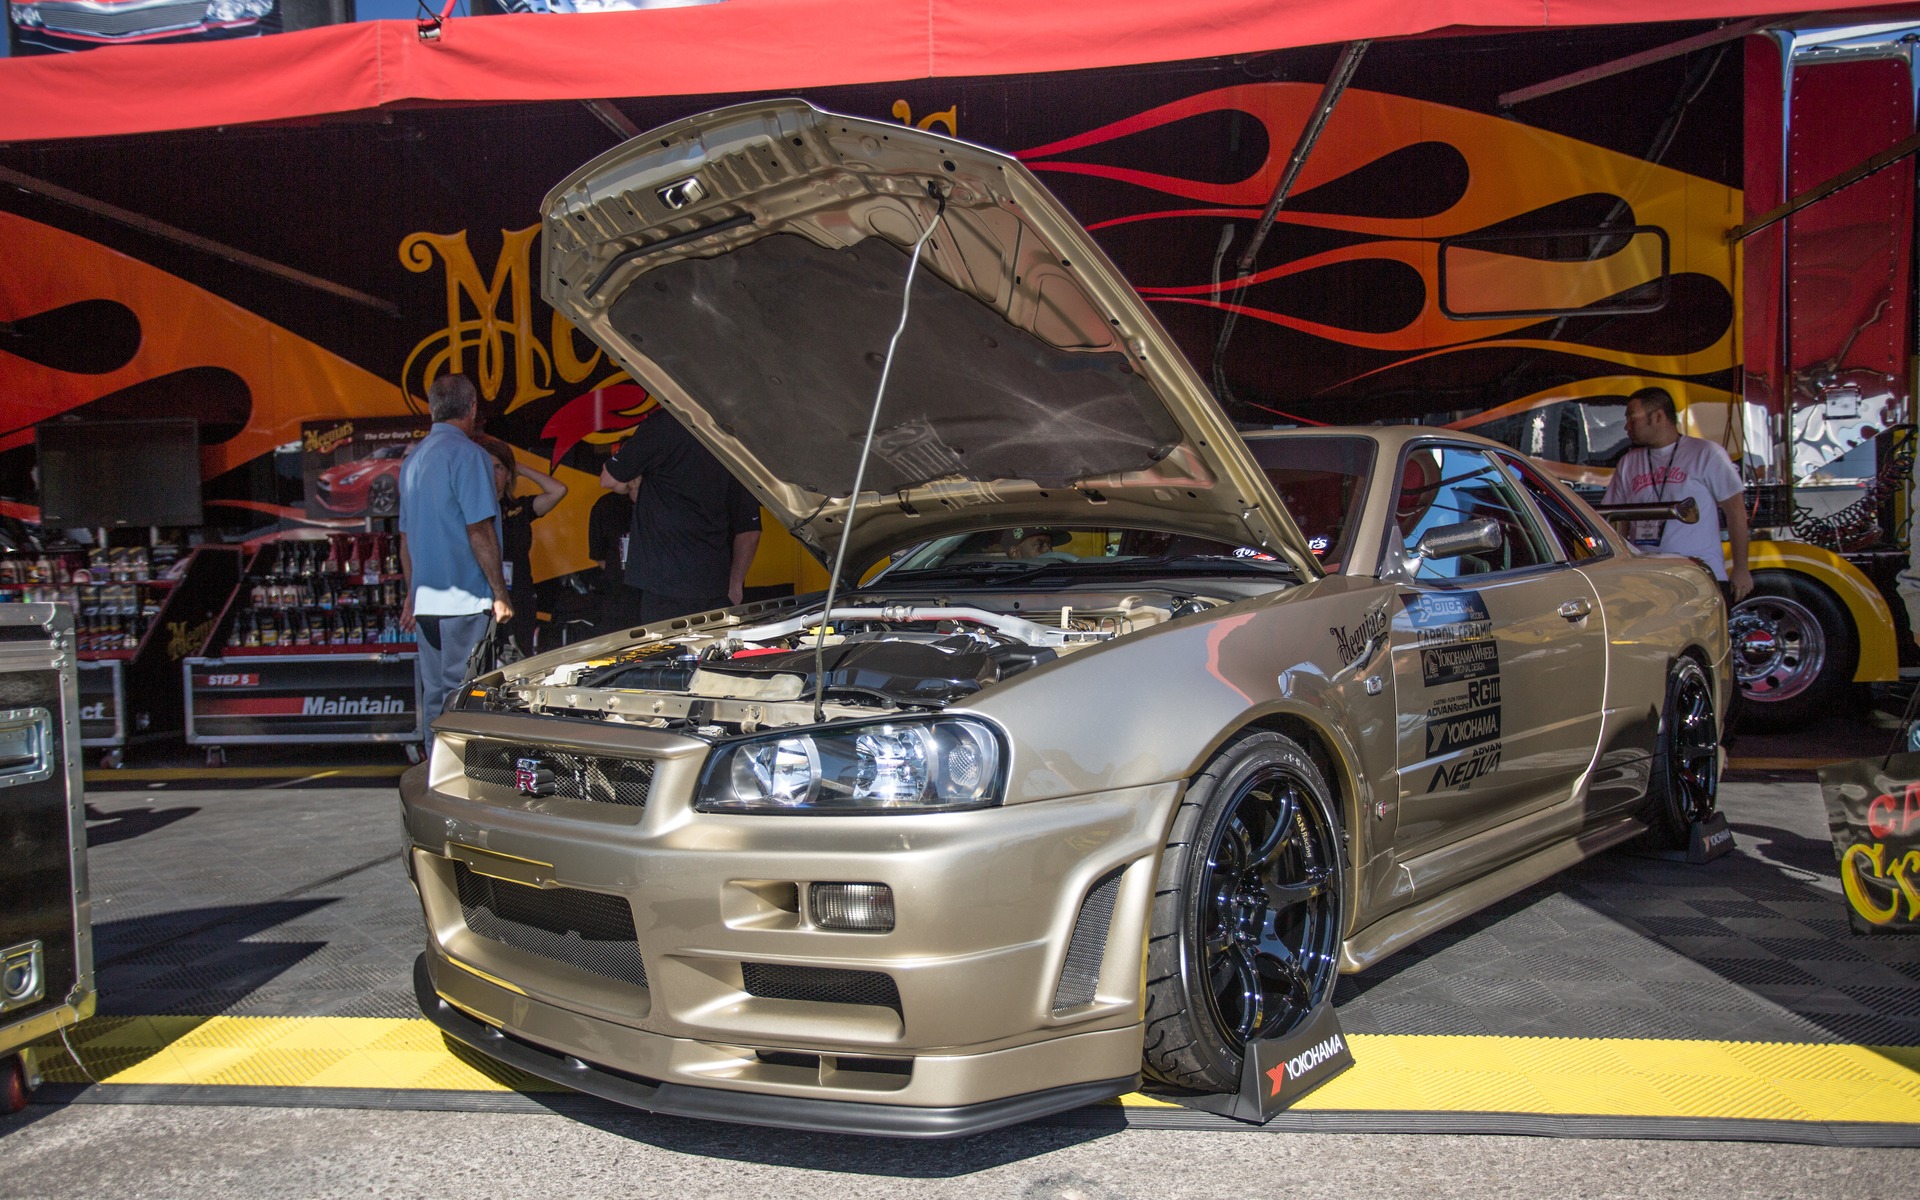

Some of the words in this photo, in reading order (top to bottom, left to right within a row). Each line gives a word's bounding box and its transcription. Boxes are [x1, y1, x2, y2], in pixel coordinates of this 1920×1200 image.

[1417, 626, 1455, 648] CARBON
[1459, 622, 1493, 642] CERAMIC
[208, 674, 239, 685] STEP
[241, 674, 249, 684] 5
[80, 702, 105, 719] ct
[302, 696, 405, 715] Maintain
[1426, 703, 1453, 718] ADVAN
[1453, 701, 1469, 713] Racing
[1472, 742, 1502, 757] ADVAN
[1426, 751, 1501, 793] NEOVA
[1285, 1033, 1343, 1080] YOKOHAMA
